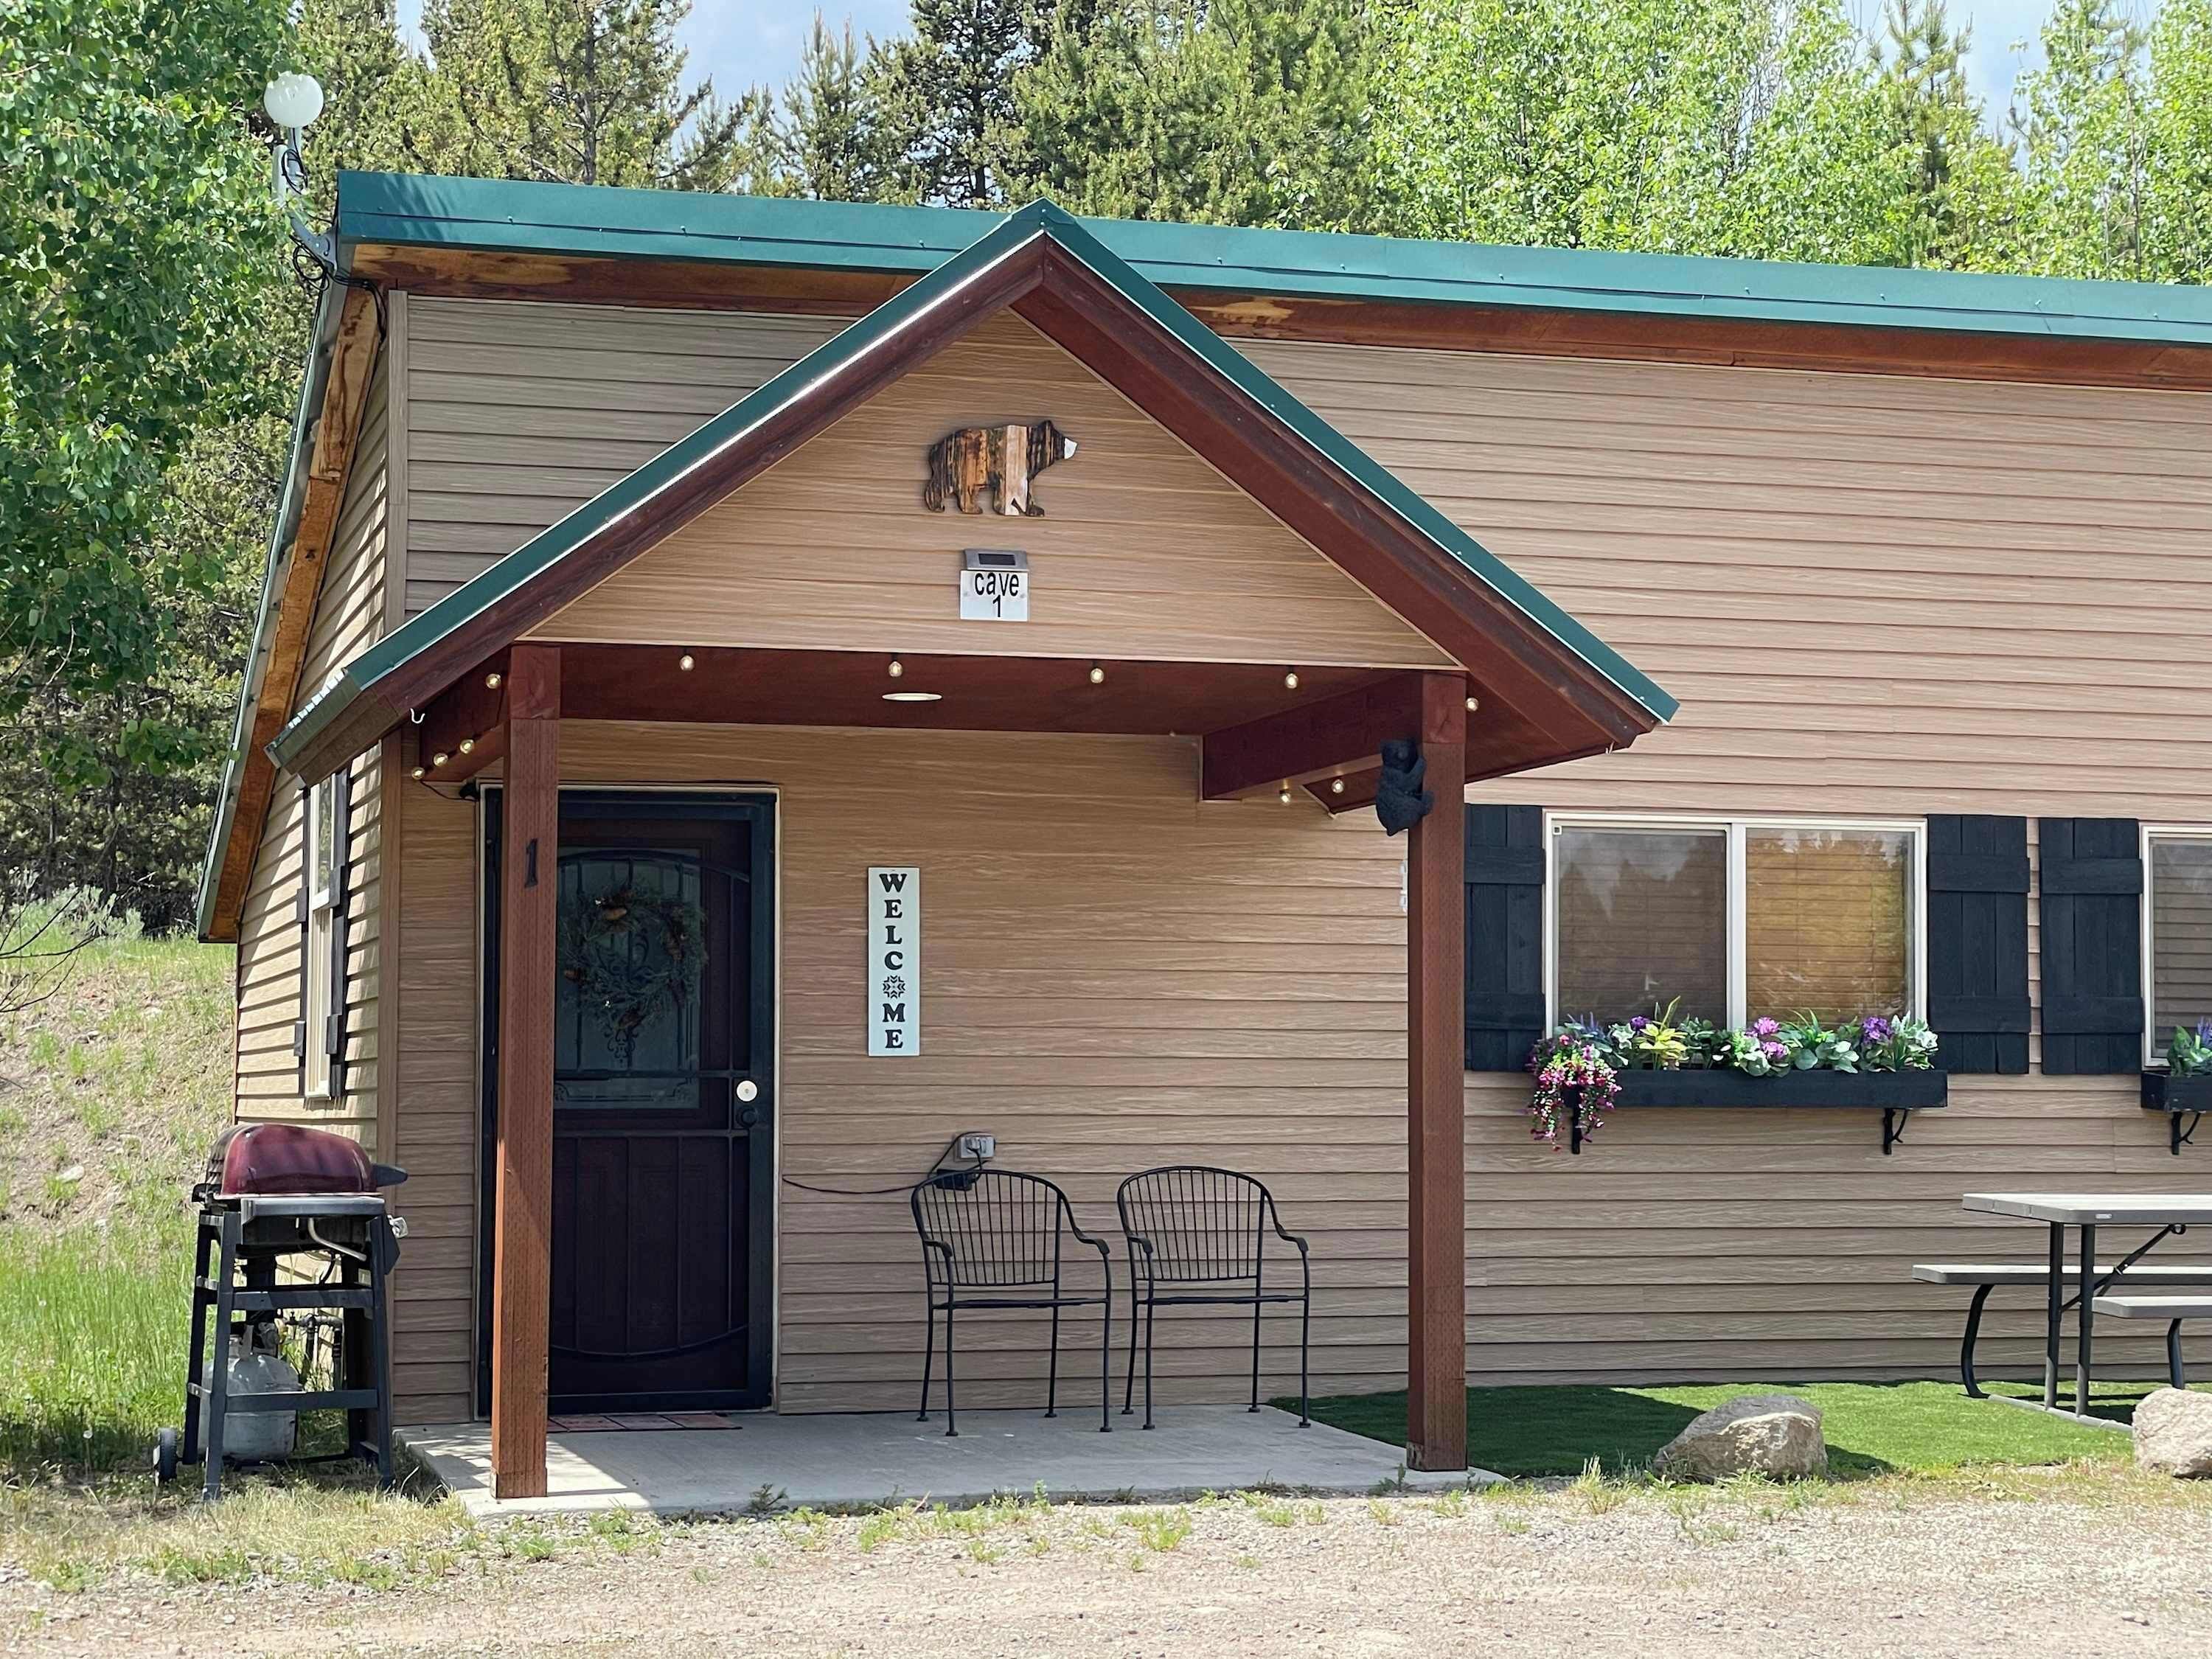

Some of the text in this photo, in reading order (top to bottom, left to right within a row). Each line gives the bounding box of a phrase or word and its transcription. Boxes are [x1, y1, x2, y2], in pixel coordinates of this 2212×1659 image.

[975, 572, 1019, 596] cave
[992, 594, 1001, 618] 1
[524, 838, 538, 888] 1
